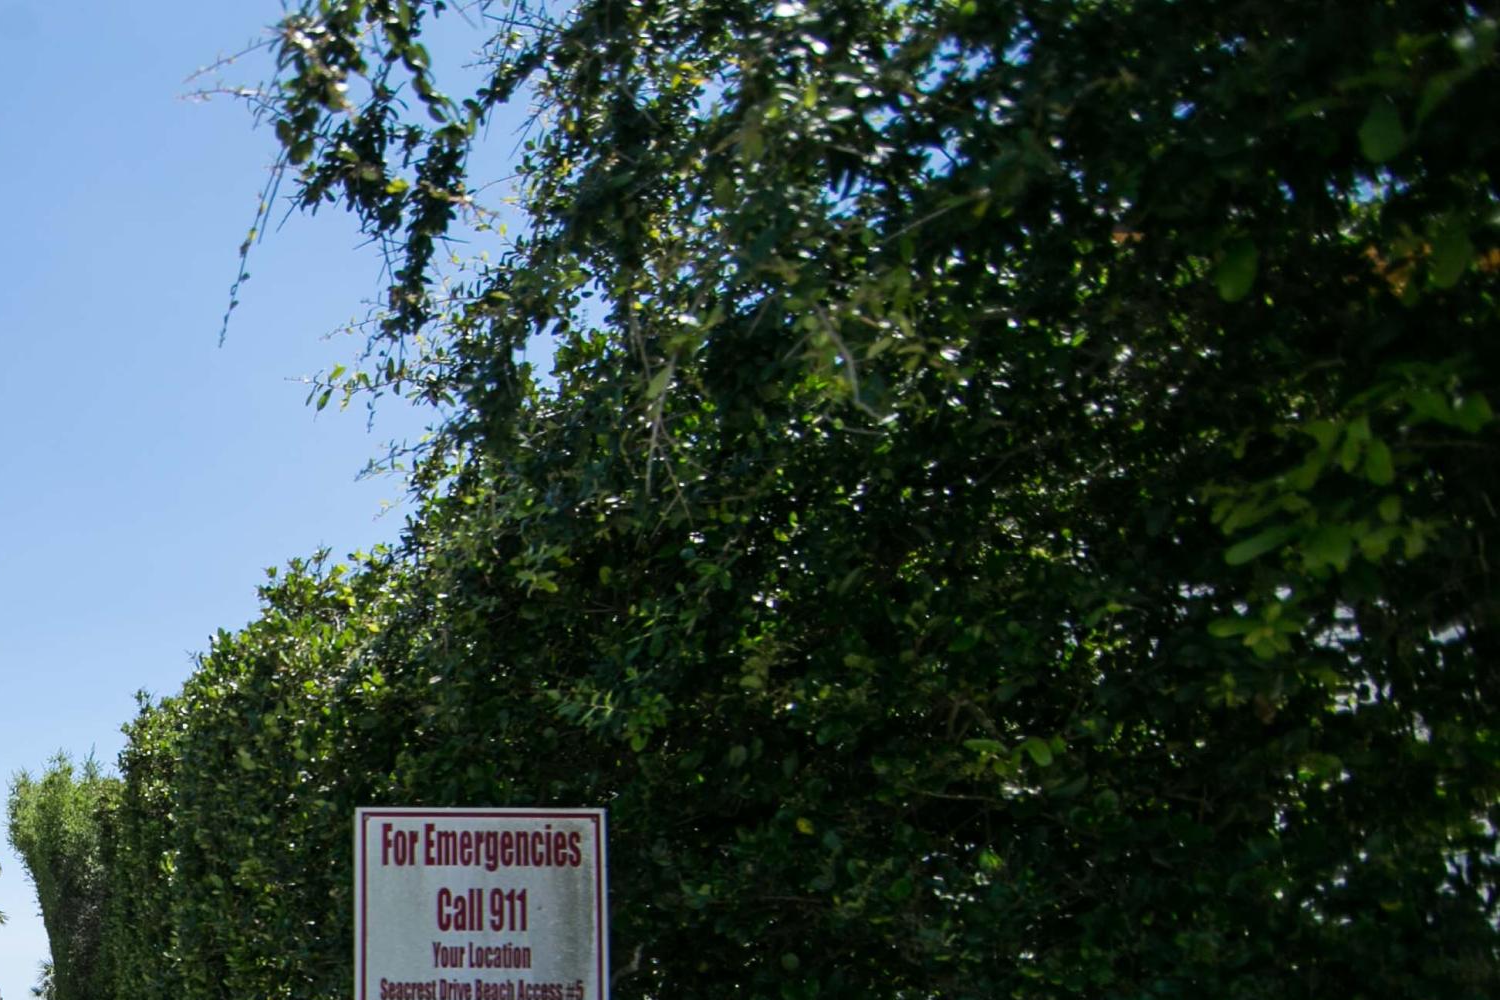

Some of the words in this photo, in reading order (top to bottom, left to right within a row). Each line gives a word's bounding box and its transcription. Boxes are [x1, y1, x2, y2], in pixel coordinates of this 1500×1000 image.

[382, 823, 418, 866] For
[424, 823, 581, 871] Emergencies
[437, 887, 483, 931] Call
[490, 888, 527, 931] 911
[432, 942, 465, 968] Your
[469, 942, 531, 969] Location
[380, 977, 437, 1000] Seacrest
[439, 978, 472, 1000] Drive
[475, 979, 514, 1000] Beach
